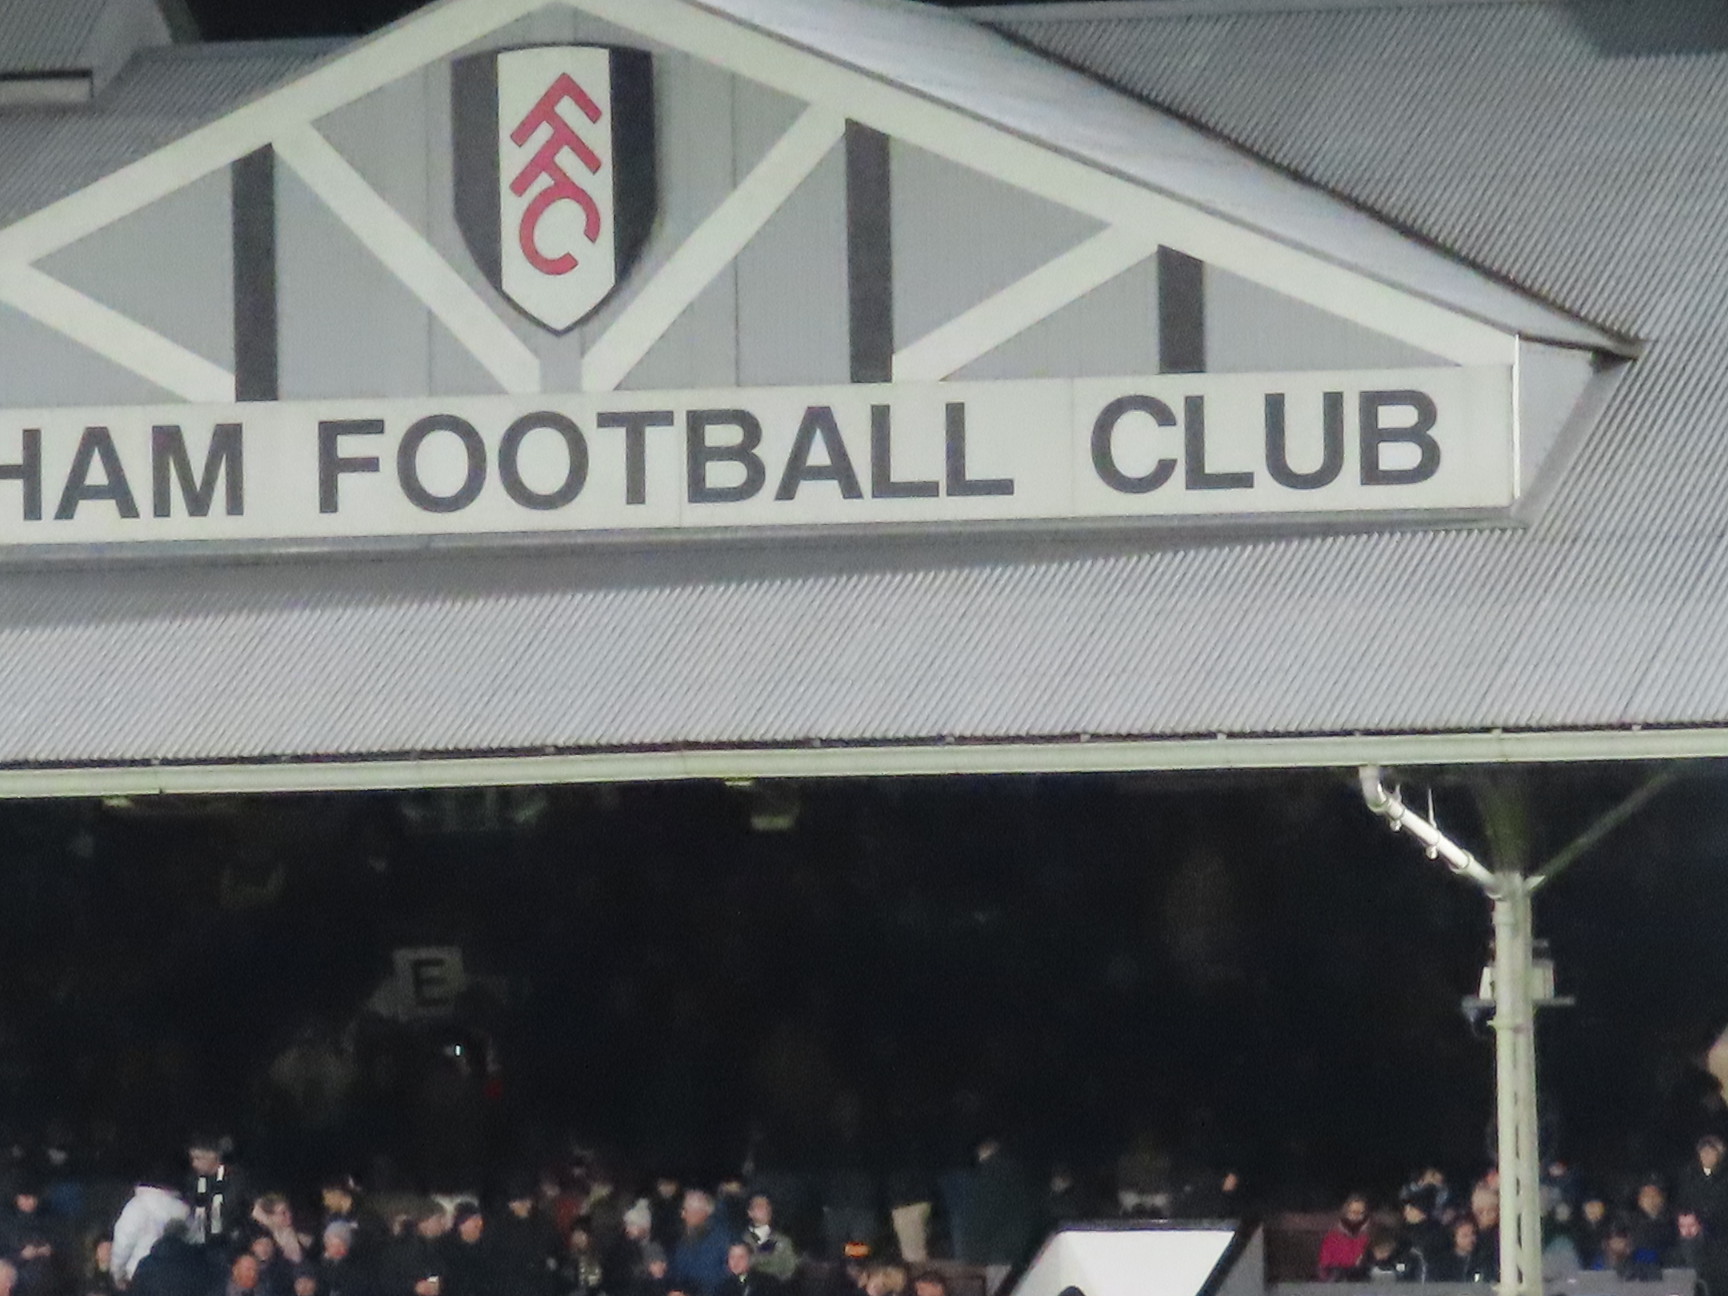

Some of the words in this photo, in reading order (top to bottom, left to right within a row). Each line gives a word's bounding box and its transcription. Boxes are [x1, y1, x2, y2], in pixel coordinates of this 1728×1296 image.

[510, 72, 602, 276] FFC
[319, 402, 1014, 513] FOOTBALL
[1091, 389, 1442, 494] CLUB
[412, 958, 449, 1006] E
